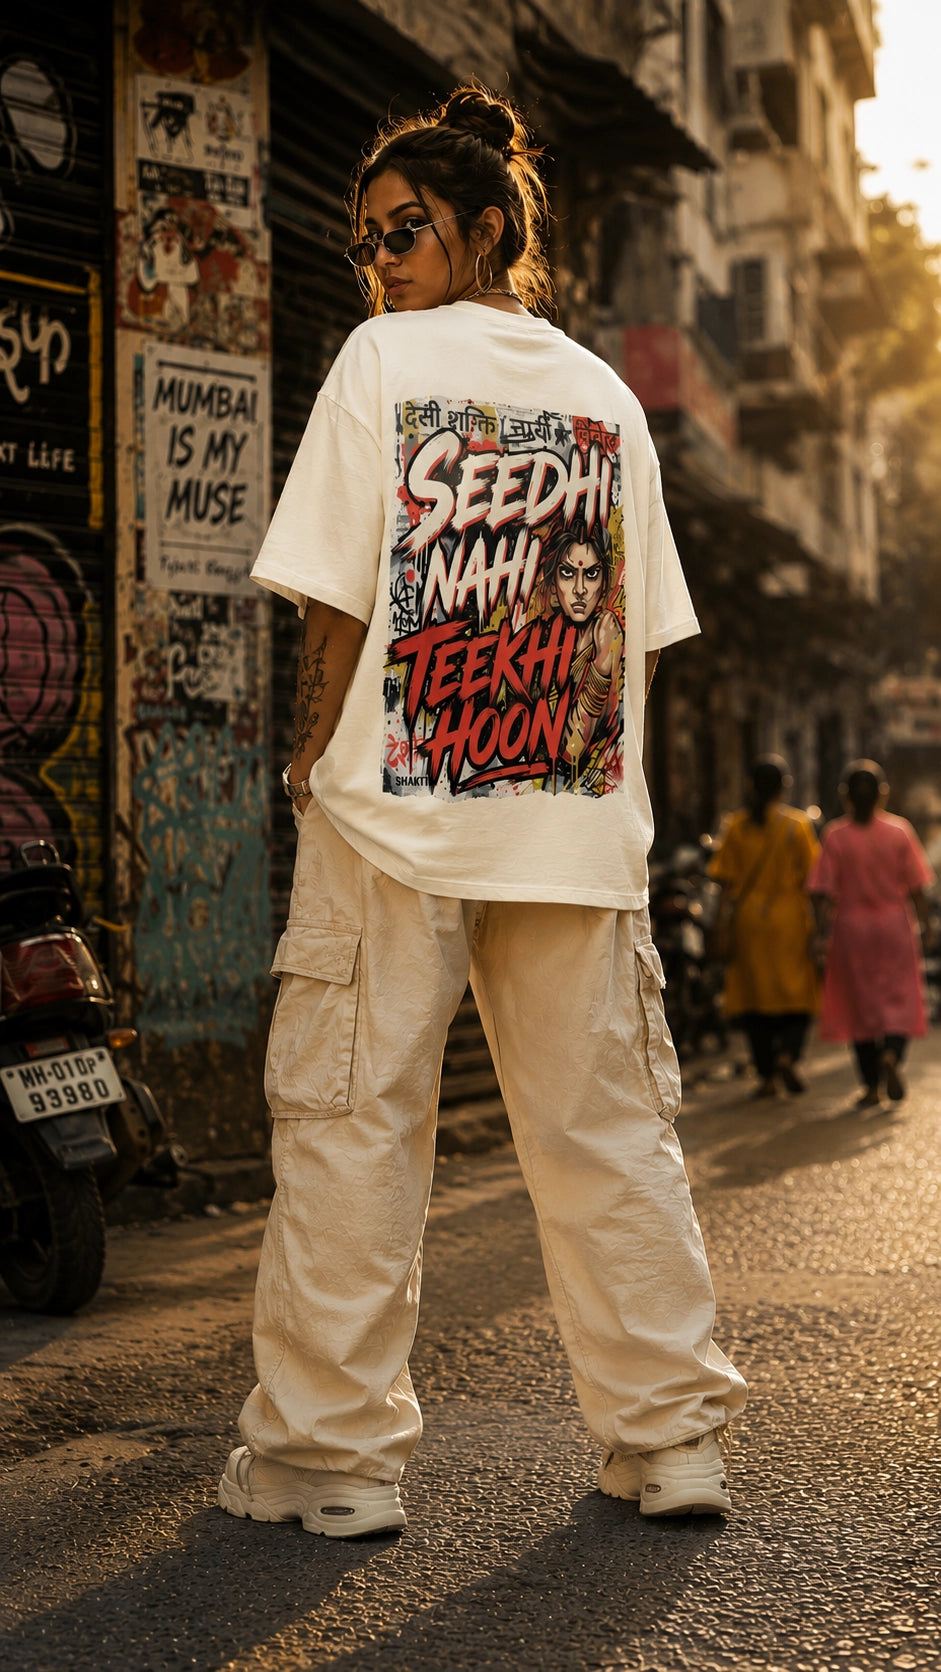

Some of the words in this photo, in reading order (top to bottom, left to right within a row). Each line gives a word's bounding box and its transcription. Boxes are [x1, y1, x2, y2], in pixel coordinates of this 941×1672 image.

[153, 375, 258, 424] MUMBAI
[167, 424, 195, 467] IS
[203, 430, 249, 475] MY
[166, 476, 248, 527] MUSE
[395, 430, 613, 548] SEEDHI
[421, 529, 542, 628] NAHI
[391, 613, 577, 720] TEEKHI
[422, 690, 570, 779] HOON
[28, 1079, 110, 1114] 93980
